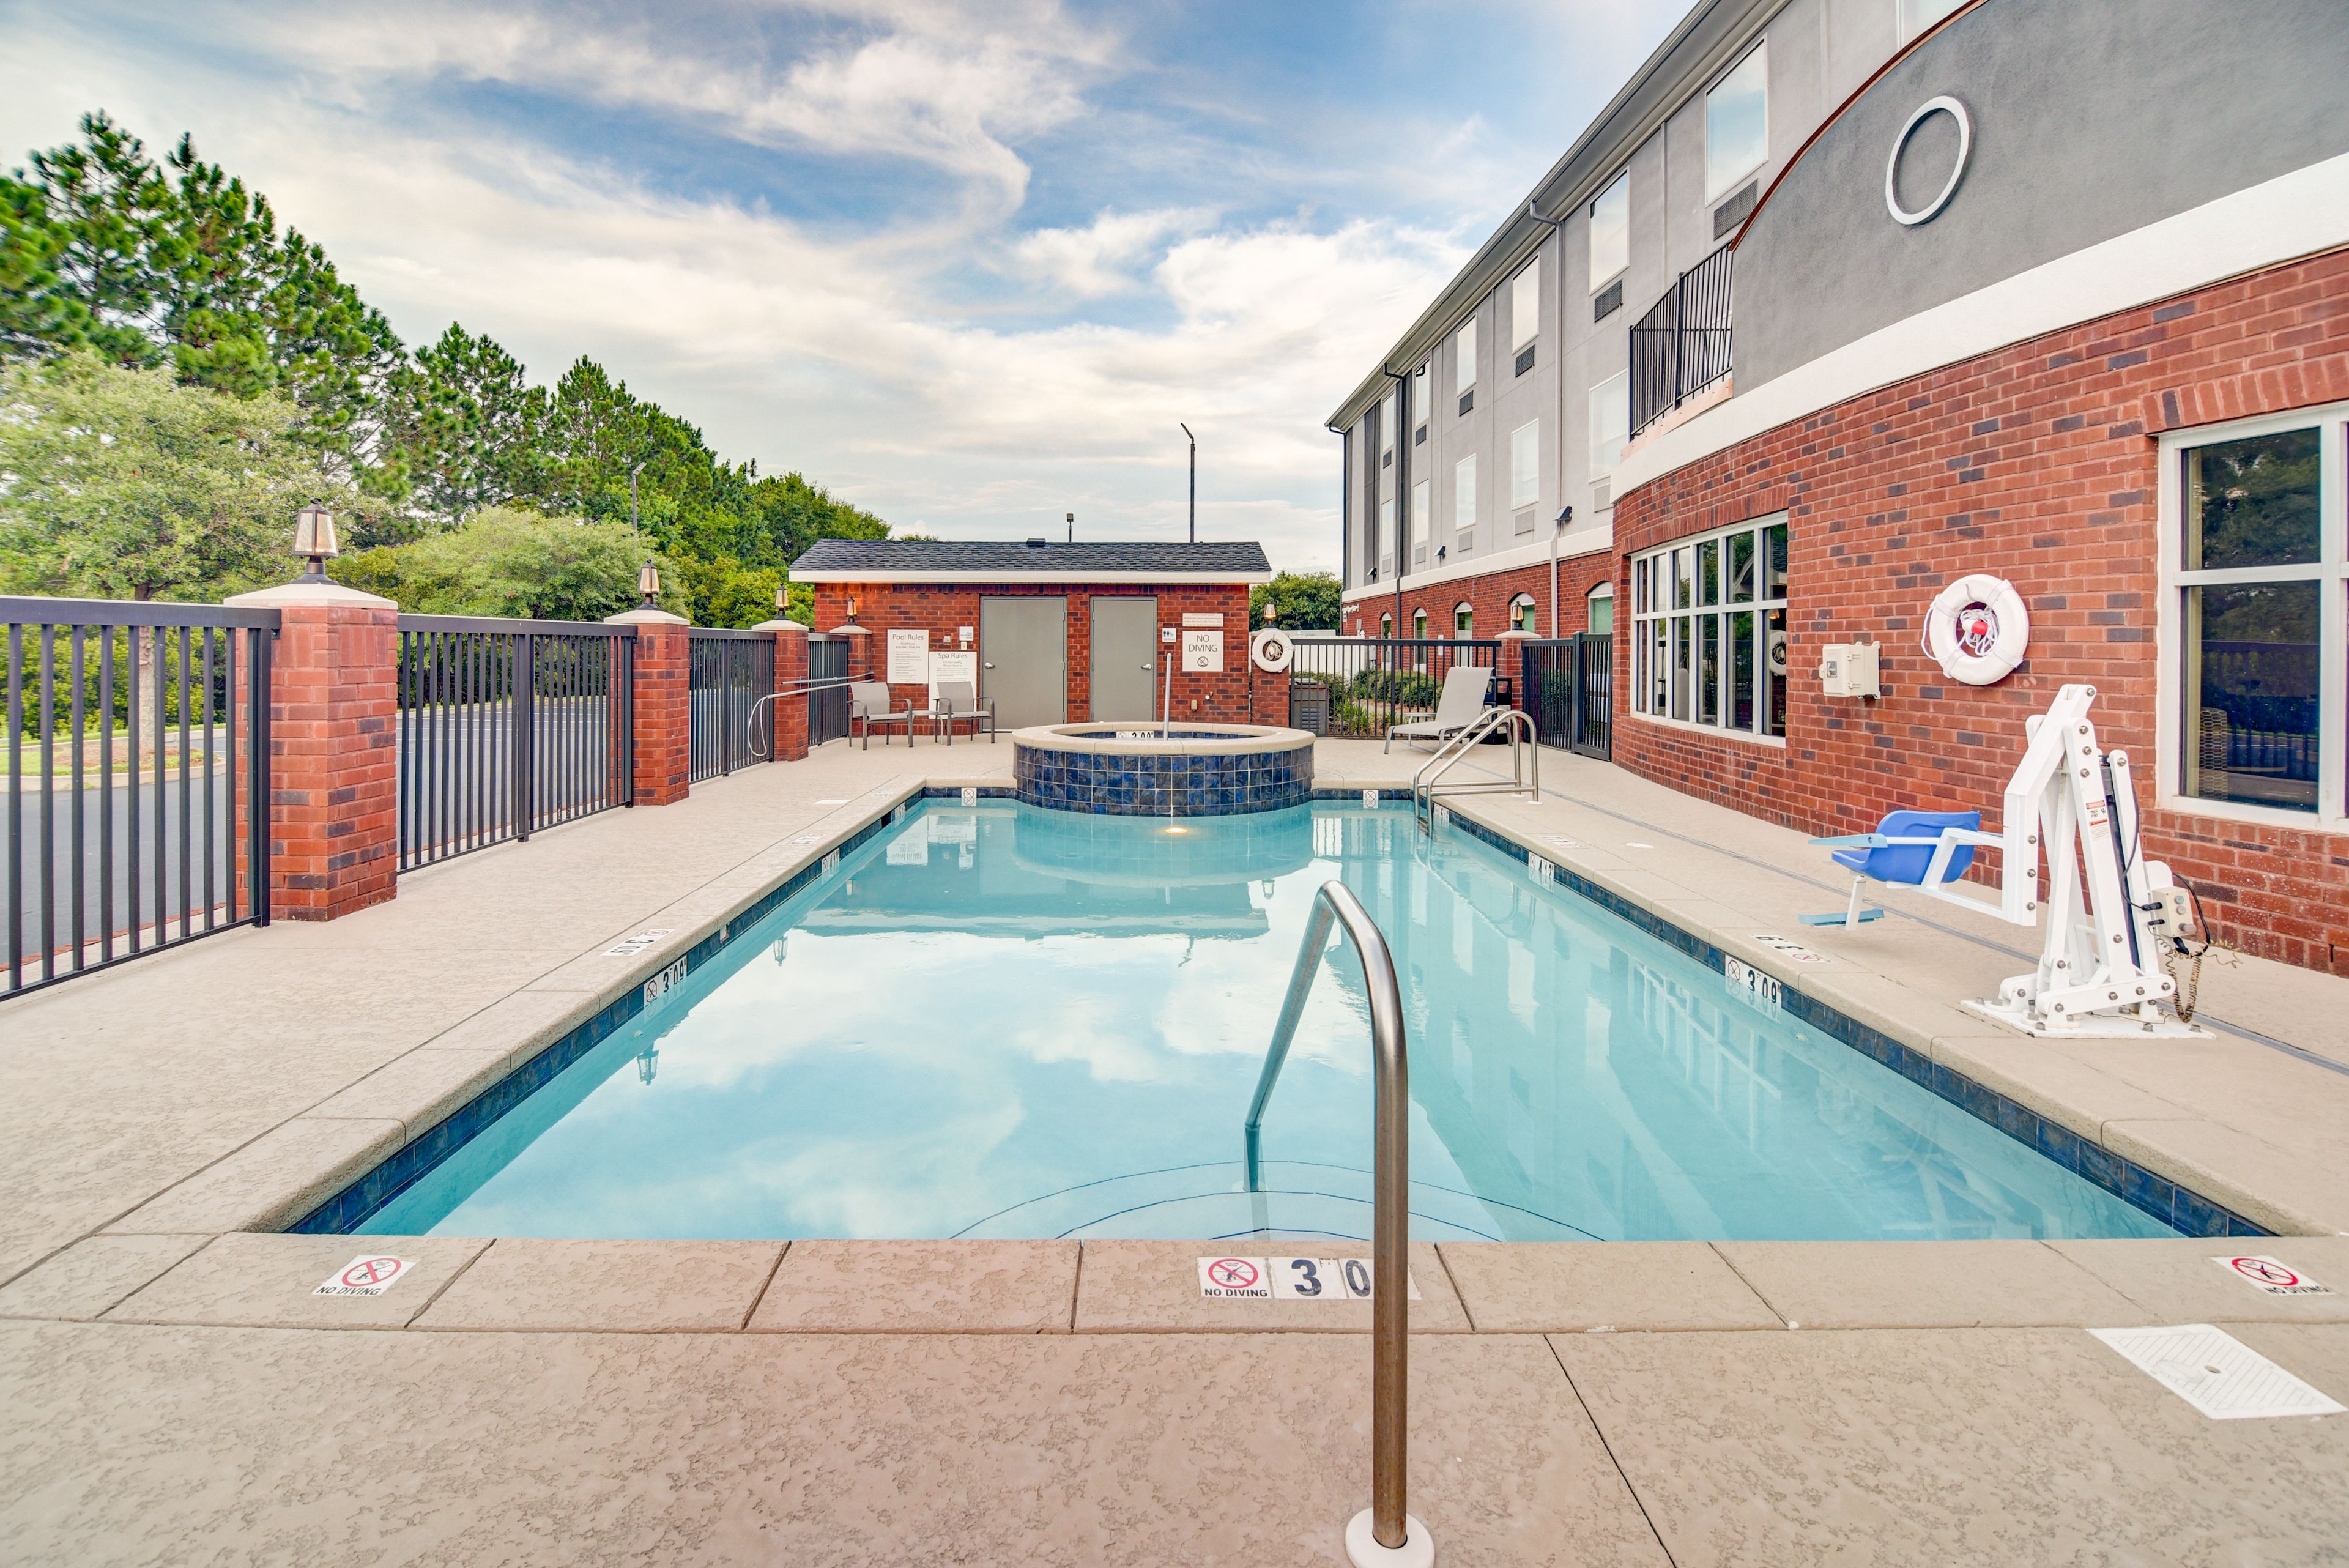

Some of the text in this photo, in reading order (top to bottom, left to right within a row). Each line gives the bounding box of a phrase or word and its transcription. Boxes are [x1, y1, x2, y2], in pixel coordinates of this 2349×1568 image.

[663, 971, 669, 993] 3
[1748, 970, 1756, 992] 3
[1291, 1258, 1322, 1296] 3
[337, 1287, 382, 1296] DIVING
[1226, 1288, 1267, 1297] DIVING
